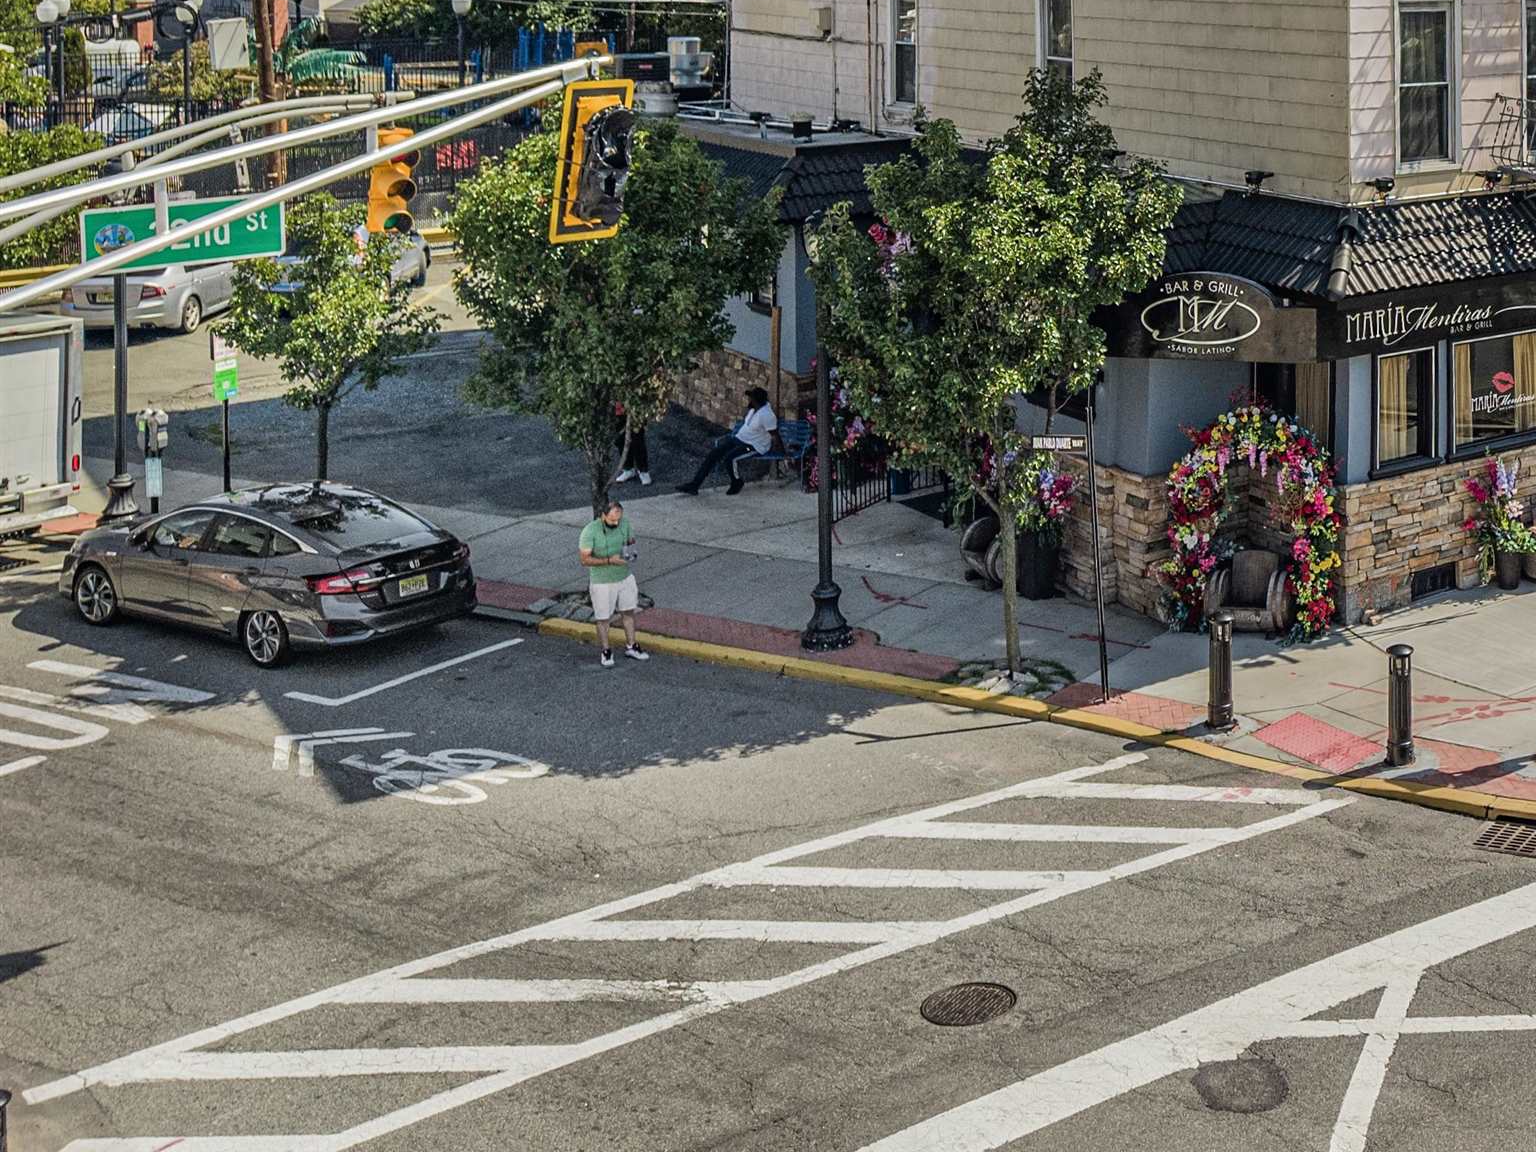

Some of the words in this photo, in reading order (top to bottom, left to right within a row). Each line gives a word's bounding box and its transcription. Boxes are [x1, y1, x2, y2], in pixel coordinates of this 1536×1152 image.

[246, 211, 269, 232] St
[1165, 280, 1190, 295] BAR
[1193, 279, 1204, 292] &
[1208, 280, 1240, 298] GRILL
[1402, 301, 1493, 336] Mentiras
[1451, 326, 1464, 334] BAR
[1474, 319, 1493, 330] GRILL
[1171, 344, 1198, 354] SABOR
[1201, 345, 1232, 355] LATINO
